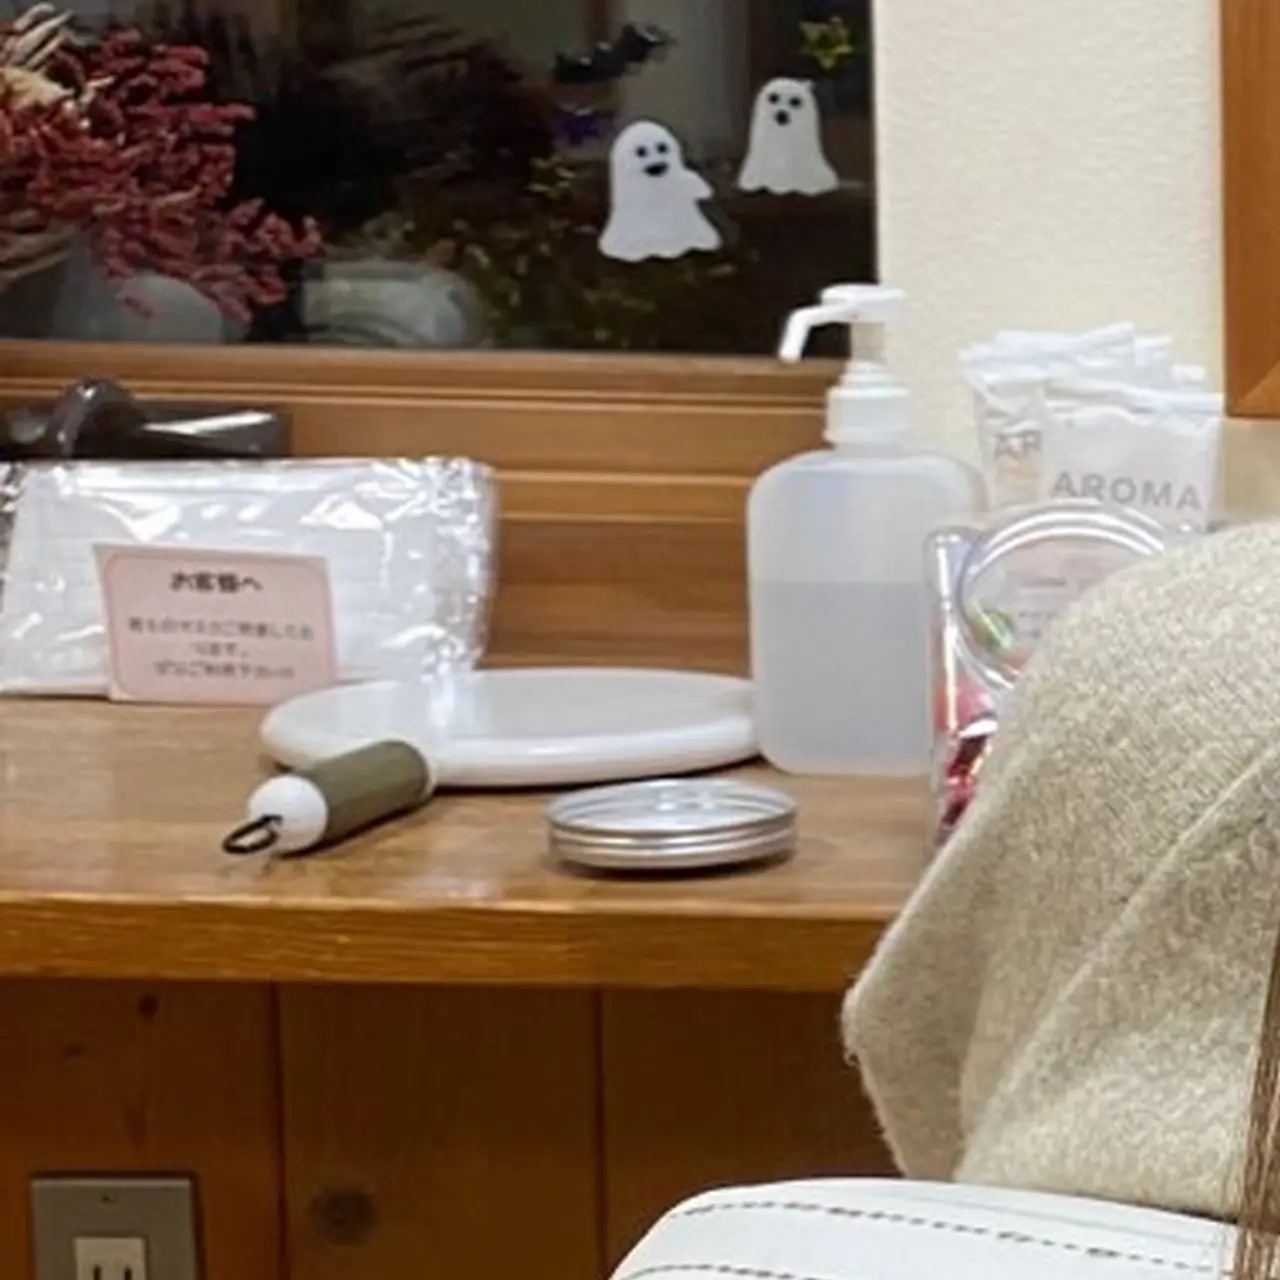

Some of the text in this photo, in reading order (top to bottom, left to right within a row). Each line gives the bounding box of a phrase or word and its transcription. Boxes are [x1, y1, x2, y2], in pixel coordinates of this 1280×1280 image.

[1051, 471, 1201, 511] AROMA
[170, 572, 264, 594] お客様へ
